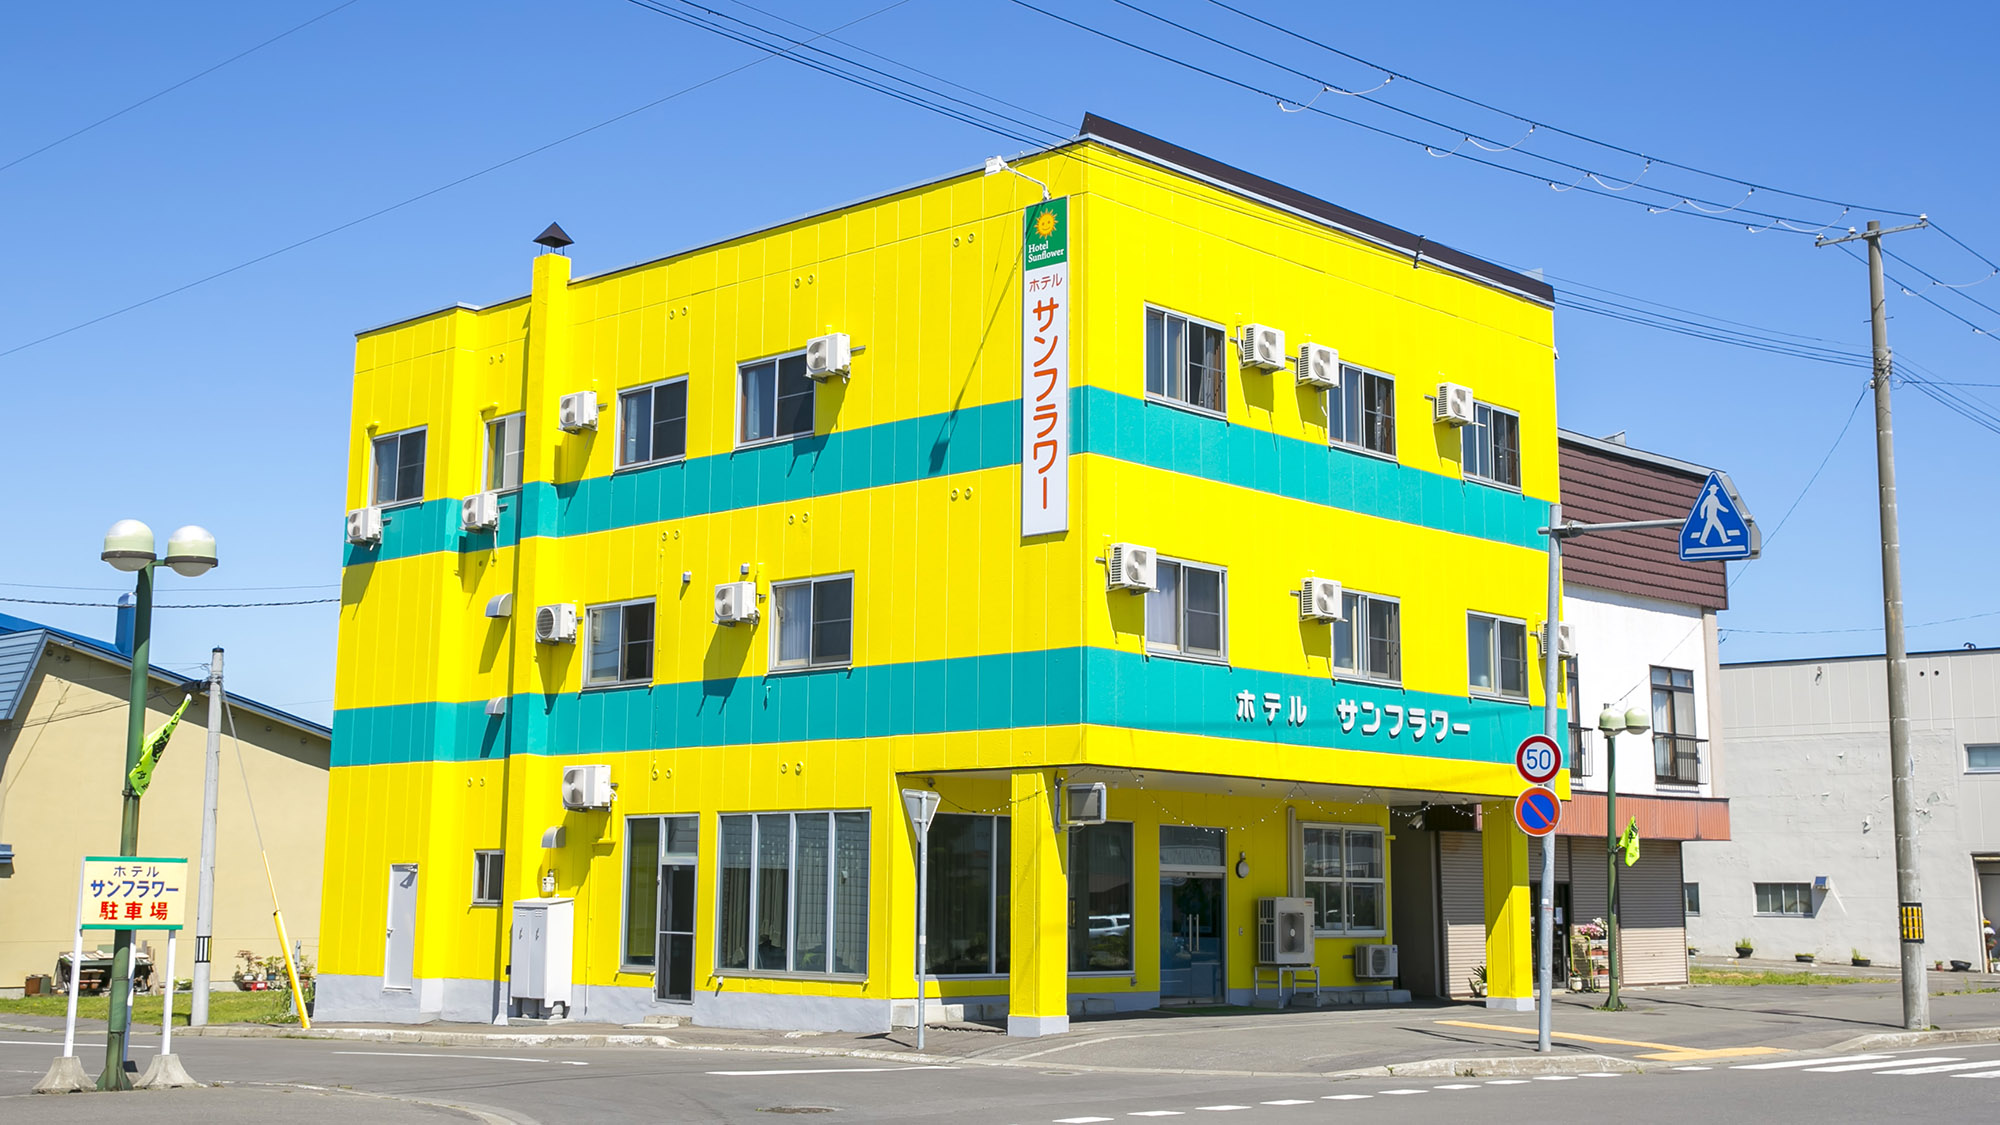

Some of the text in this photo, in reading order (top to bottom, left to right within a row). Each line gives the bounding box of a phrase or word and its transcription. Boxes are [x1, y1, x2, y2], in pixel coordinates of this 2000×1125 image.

[1028, 240, 1049, 253] Hotel
[1028, 248, 1065, 263] Sunflower
[1029, 273, 1063, 292] ホテル
[1033, 297, 1059, 510] サンフラワー
[1236, 689, 1471, 743] ホテル サンフラワー
[1526, 749, 1551, 770] 50
[113, 865, 160, 878] ホテル
[90, 879, 179, 898] サンフラワー
[99, 901, 169, 921] 駐車場
